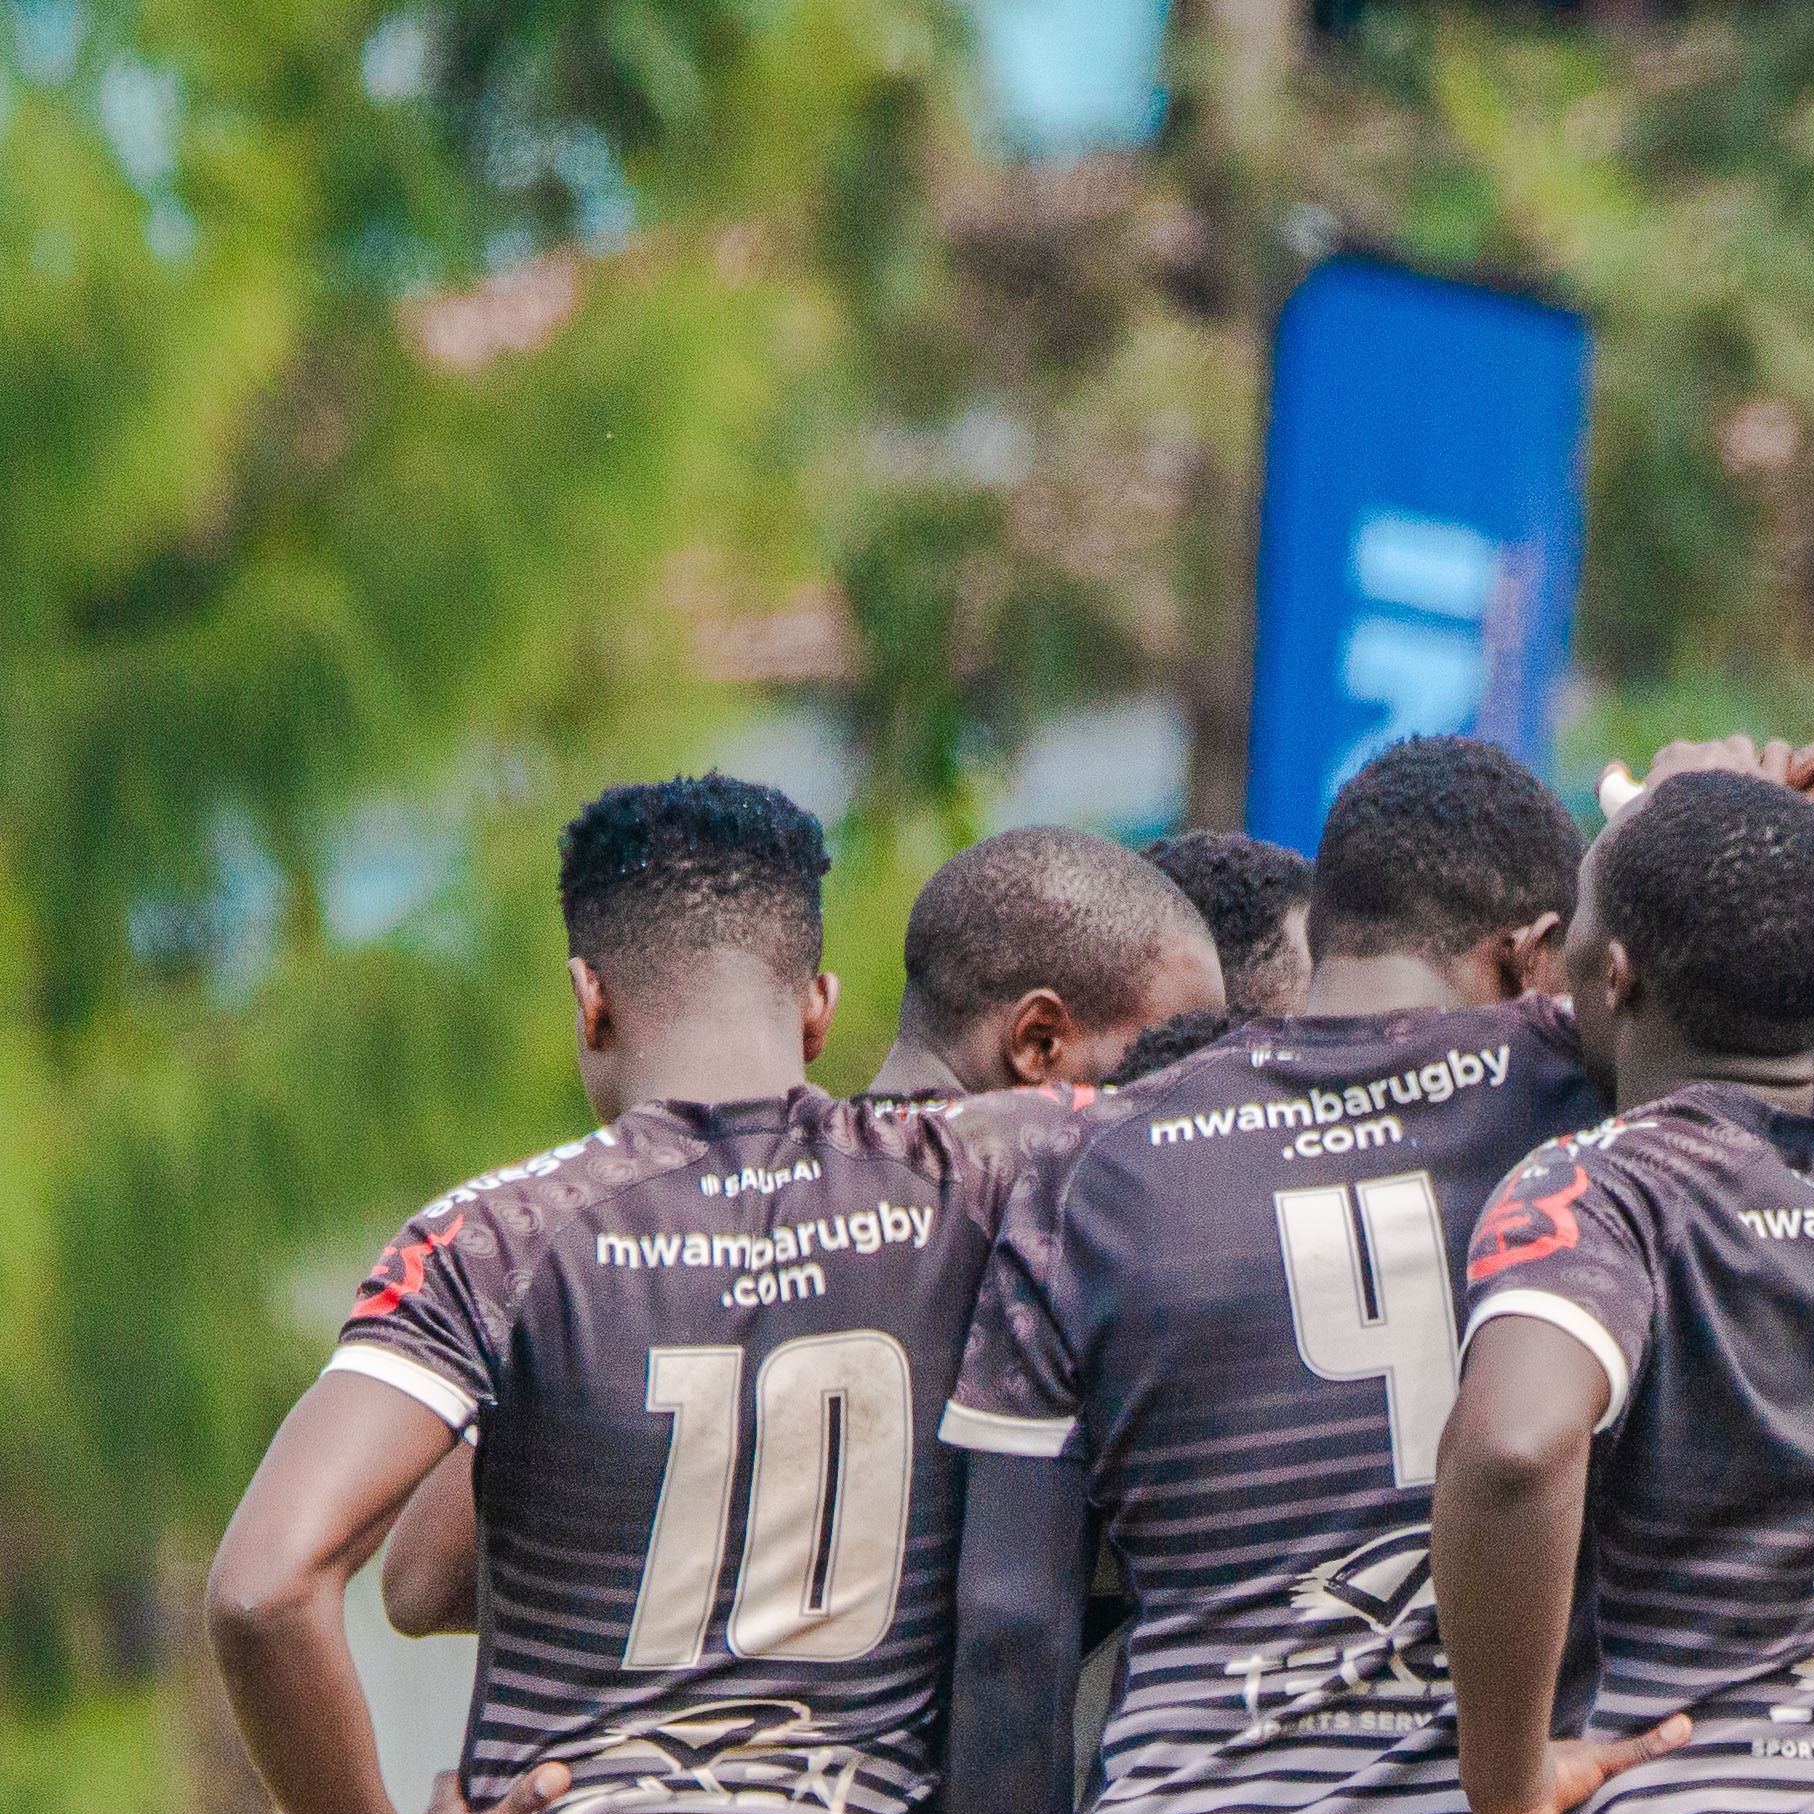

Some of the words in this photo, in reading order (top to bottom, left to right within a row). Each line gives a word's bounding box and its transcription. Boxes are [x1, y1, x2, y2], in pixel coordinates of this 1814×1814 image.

[1149, 1044, 1510, 1146] mwambarugby
[1281, 1115, 1400, 1161] .com
[720, 1262, 827, 1309] .com
[1273, 1169, 1460, 1488] 4
[620, 1328, 915, 1671] 10
